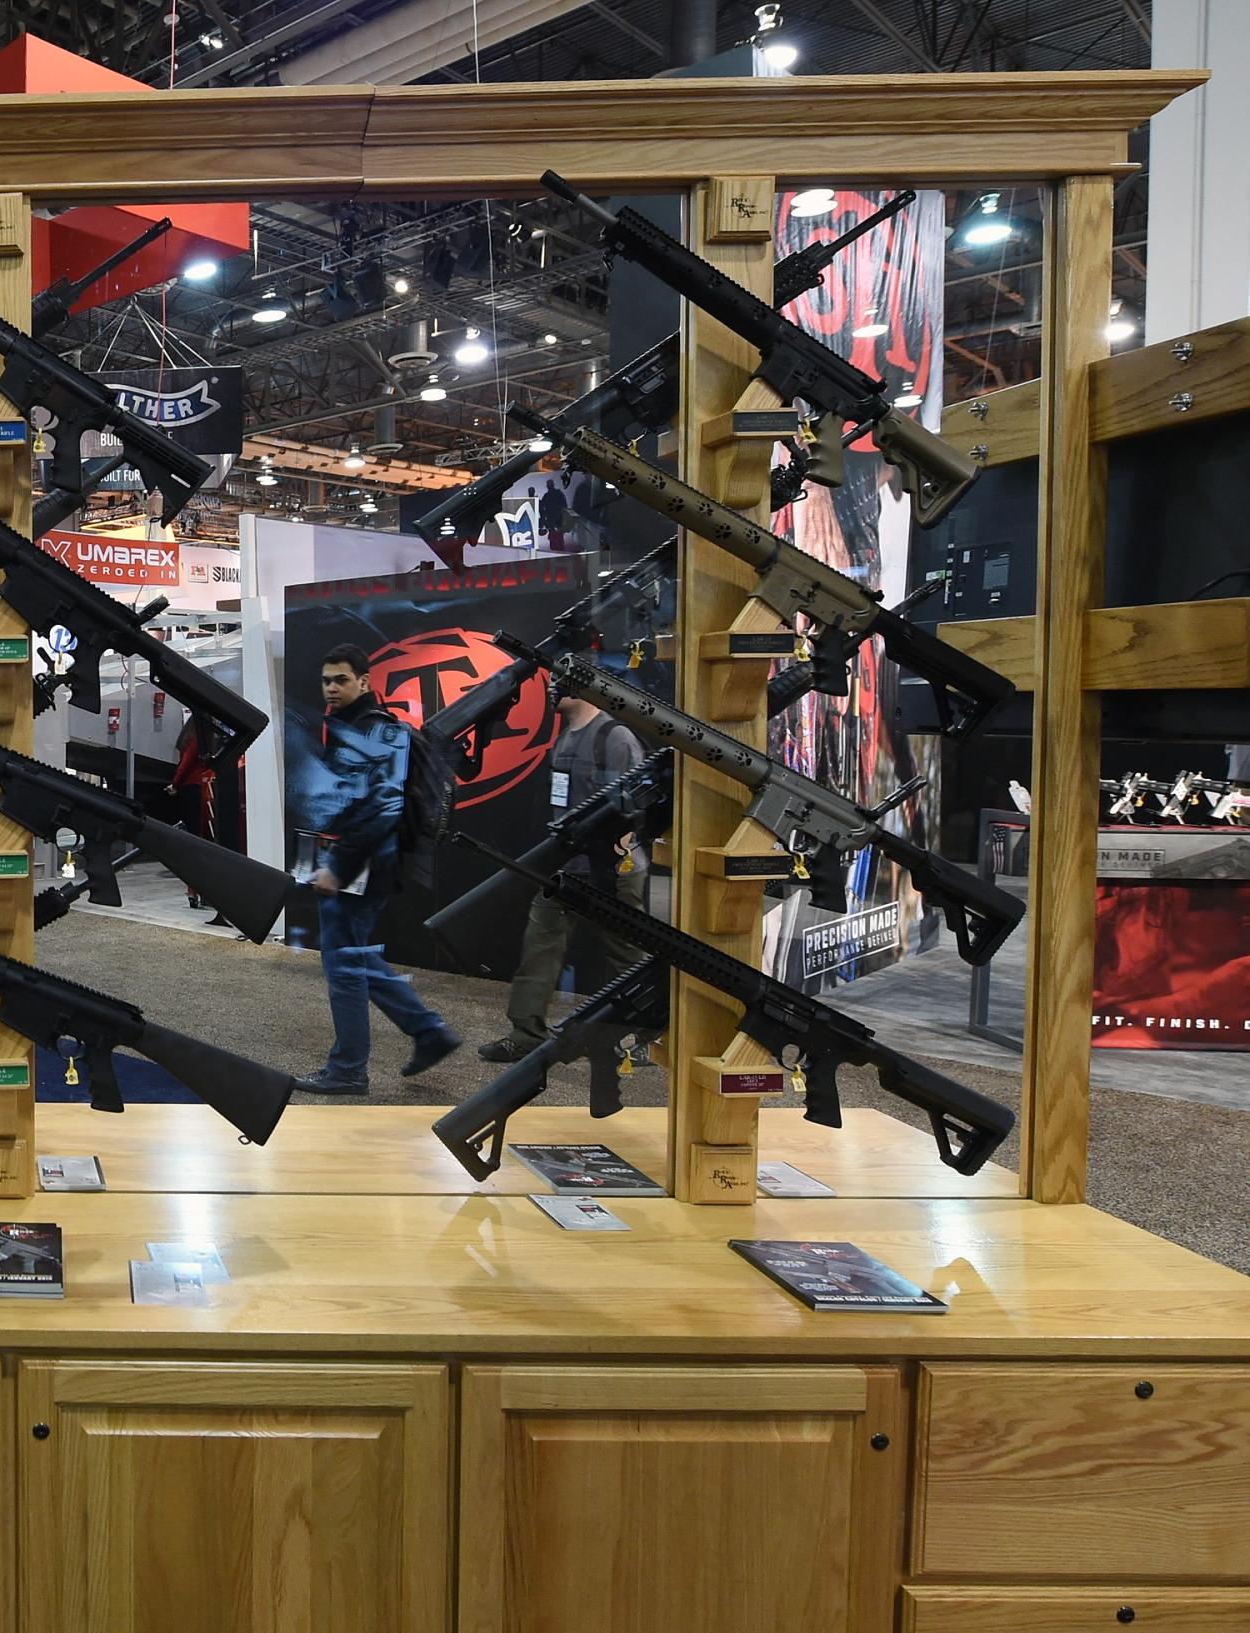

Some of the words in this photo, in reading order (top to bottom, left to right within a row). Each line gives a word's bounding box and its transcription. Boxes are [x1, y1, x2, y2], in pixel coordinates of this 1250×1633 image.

[118, 391, 194, 420] LTHER
[100, 433, 123, 447] BUIL
[100, 469, 121, 482] UILT
[77, 542, 176, 567] UMAREX
[77, 564, 148, 578] ZEROED
[160, 570, 176, 579] IN
[1118, 852, 1162, 862] MADE
[806, 918, 866, 954] PRECISION
[869, 908, 897, 933] MADE
[806, 939, 865, 970] PERFORMANCE
[867, 928, 897, 948] DEFINED
[1092, 1016, 1133, 1027] FIT.
[1146, 1017, 1230, 1029] FINISH.
